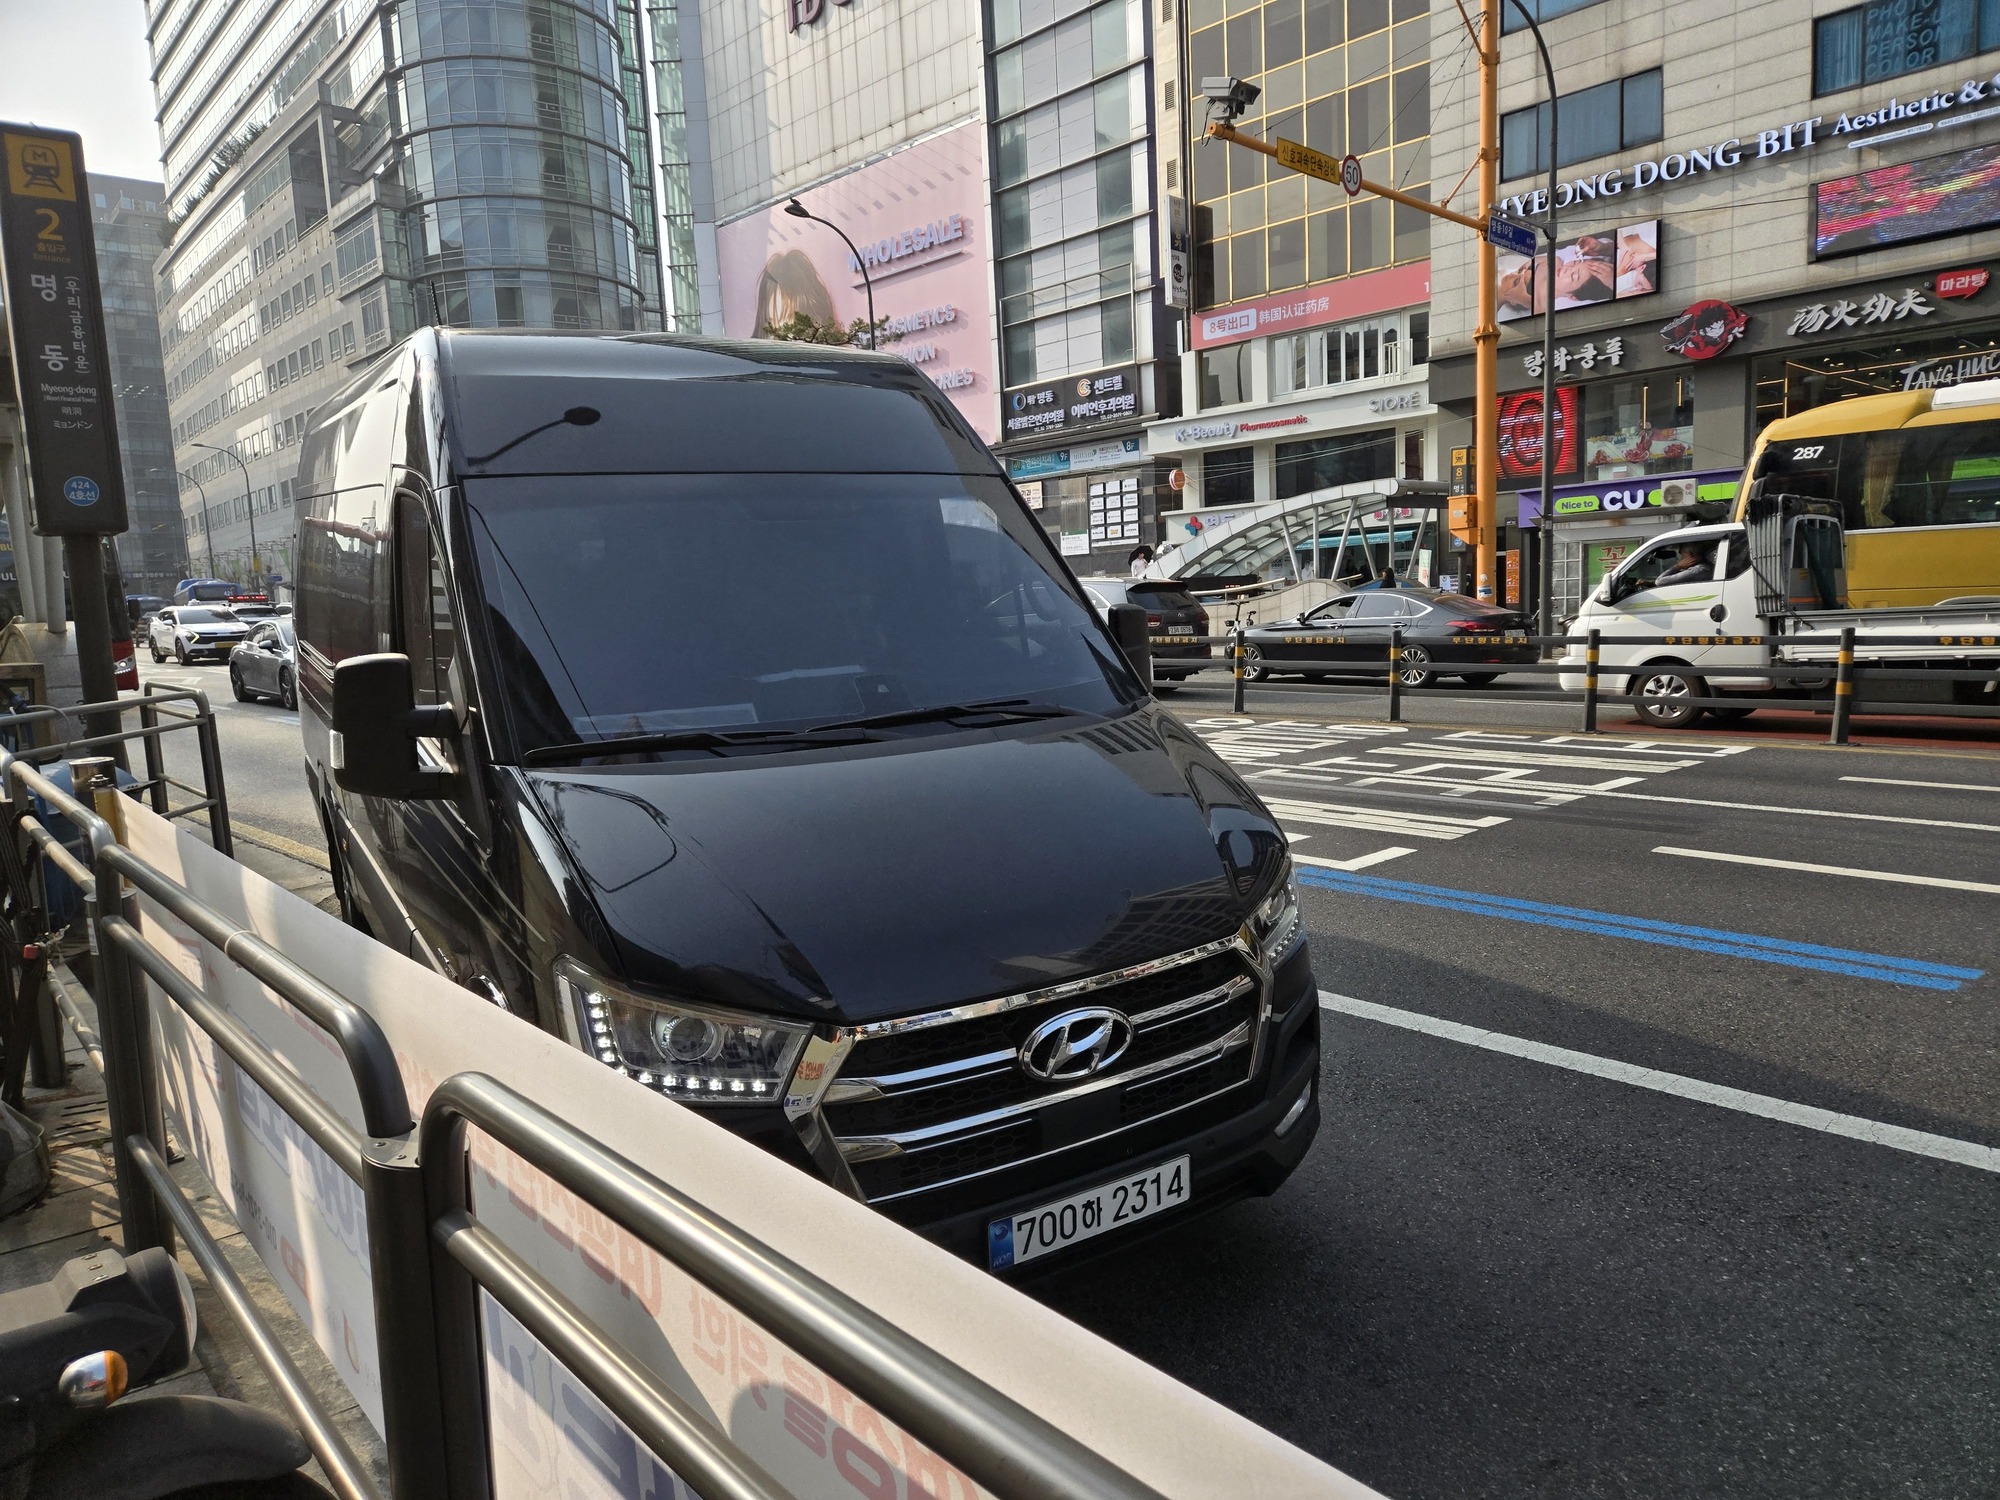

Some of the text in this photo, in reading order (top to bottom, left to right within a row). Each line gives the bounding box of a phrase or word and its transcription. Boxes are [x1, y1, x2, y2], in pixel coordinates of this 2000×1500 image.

[1867, 26, 1941, 58] PERSO
[1632, 139, 1741, 190] DONG
[1756, 116, 1823, 159] BIT
[1832, 89, 1955, 136] Aesthetic
[1958, 80, 1989, 103] &
[1282, 145, 1337, 178] 신호과속단속장비
[1345, 165, 1359, 187] 50
[35, 208, 63, 240] 2
[847, 213, 963, 272] WHOLESALE
[1940, 272, 1987, 292] 마라탕
[875, 304, 957, 335] OSMETICS
[1210, 297, 1330, 333] 8号出口 韩国认证药房
[1787, 288, 1936, 336] 汤火功夫
[41, 383, 97, 396] Myeong-dong
[1093, 374, 1123, 394] 센트럴
[1071, 393, 1135, 418] 이비인후과의원
[53, 420, 93, 429] ミョンドン
[1174, 415, 1308, 442] K-Beauty Pharmacosmetic
[1792, 445, 1825, 461] 287
[71, 481, 90, 489] 424
[1456, 468, 1462, 477] 8
[69, 491, 96, 501] 4호선
[1561, 489, 1645, 512] Nice to CU
[1016, 1164, 1184, 1256] 700하 2314
